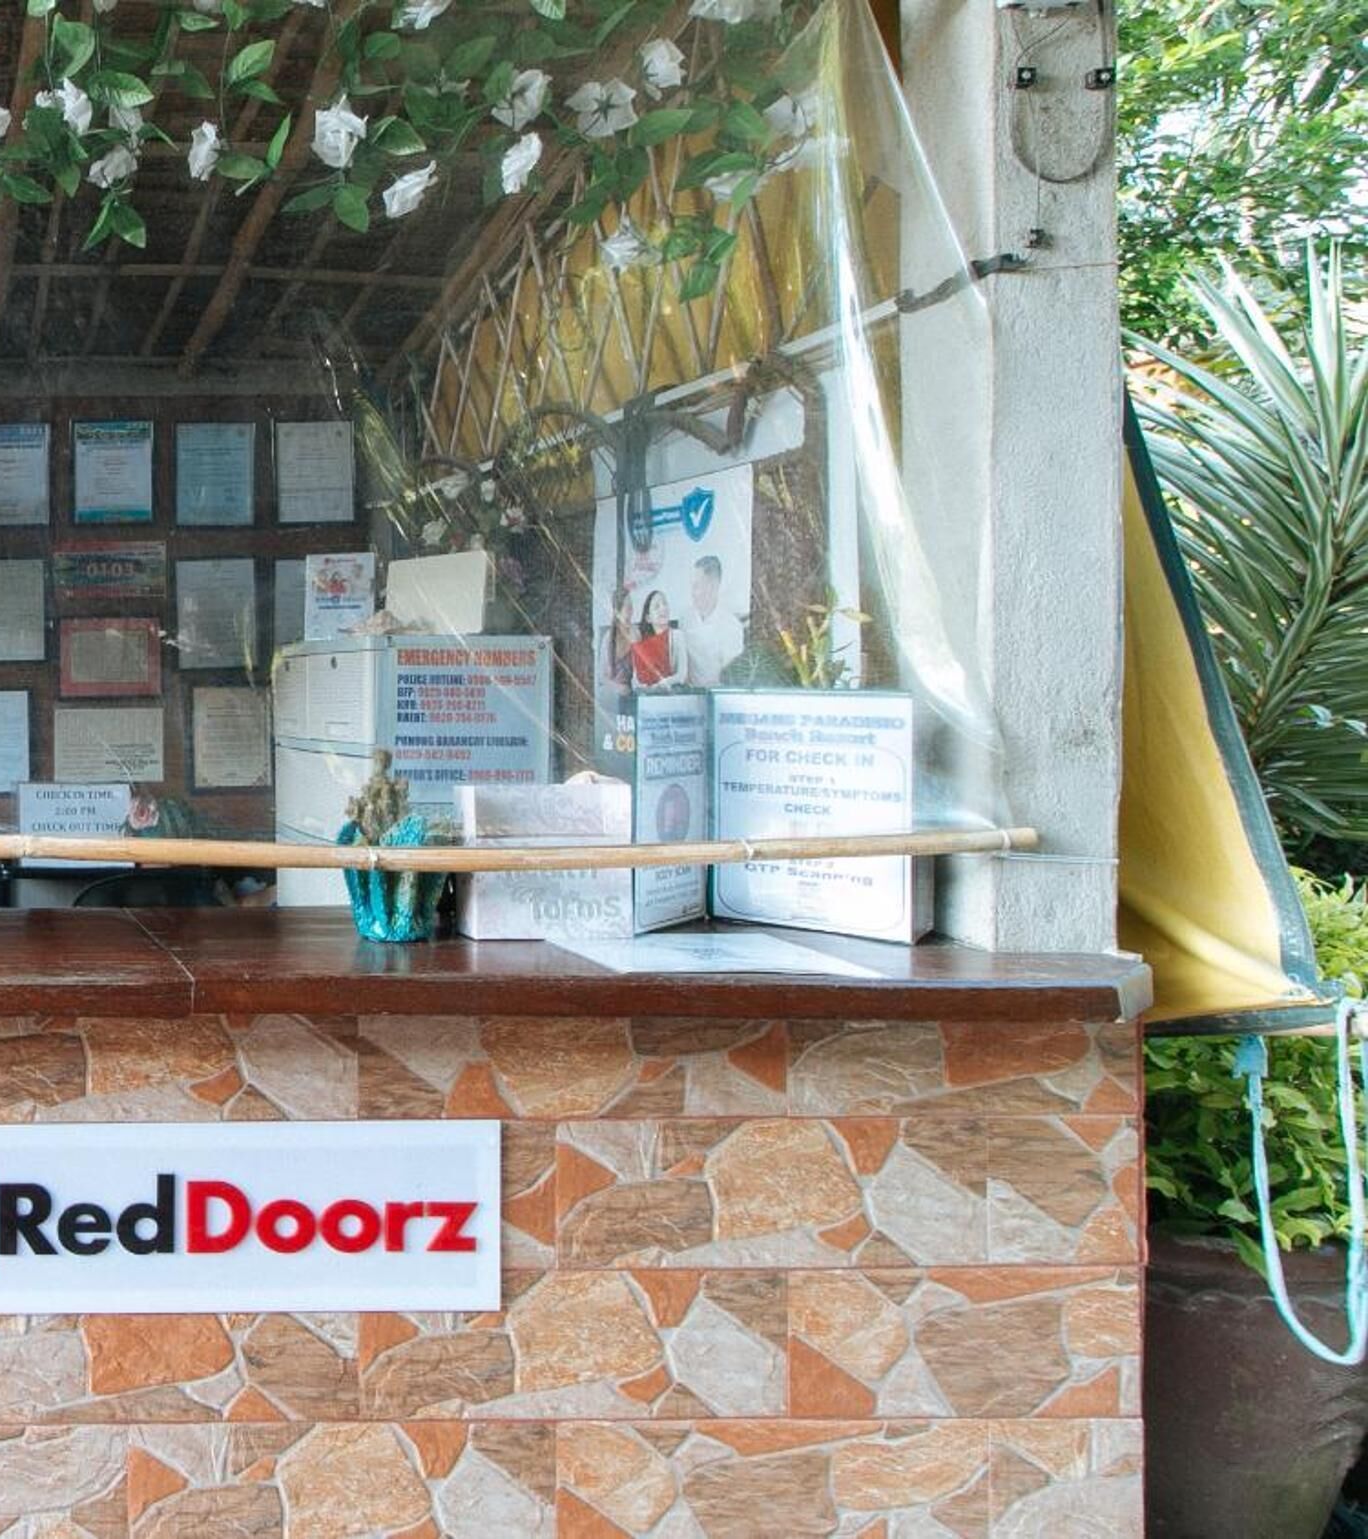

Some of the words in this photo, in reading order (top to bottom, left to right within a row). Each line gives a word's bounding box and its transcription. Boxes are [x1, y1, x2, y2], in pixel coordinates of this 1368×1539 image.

[397, 649, 469, 666] EMERGENCY
[474, 649, 537, 666] NUMBERS
[397, 674, 427, 685] POLICE
[746, 749, 779, 763] FOR
[786, 750, 847, 765] CHECK
[854, 754, 875, 766] IN
[789, 774, 822, 784] STEP
[36, 791, 72, 799] CHECK
[81, 806, 96, 815] PM
[784, 804, 831, 814] CHECK
[32, 823, 65, 832] CHECK
[68, 823, 91, 832] OUT
